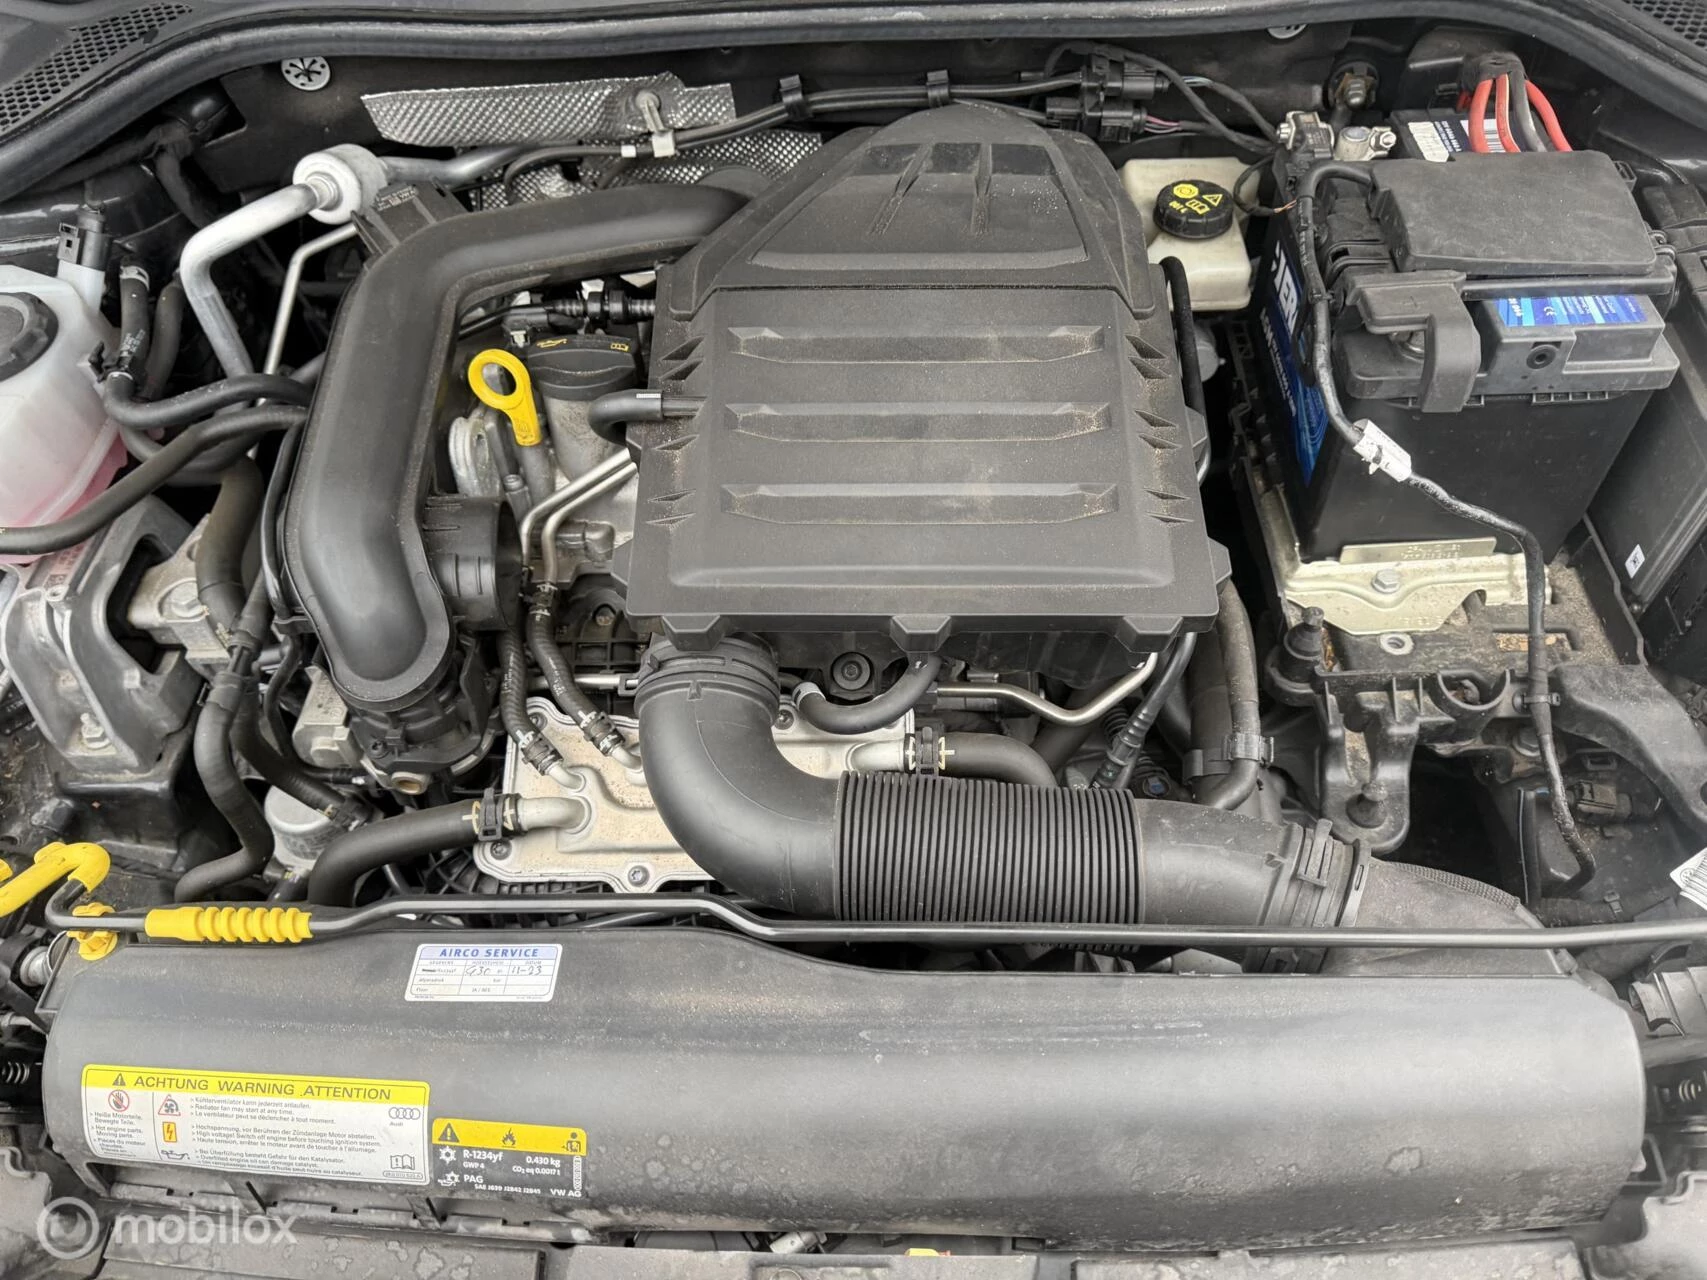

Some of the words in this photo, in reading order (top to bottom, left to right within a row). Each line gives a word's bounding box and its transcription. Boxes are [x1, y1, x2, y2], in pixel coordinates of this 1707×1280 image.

[439, 948, 479, 958] AIRCO
[484, 948, 539, 958] SERVICE
[134, 1076, 209, 1090] ACHTUNG
[218, 1080, 295, 1095] WARNING
[303, 1084, 392, 1100] ATTENTION
[463, 1150, 504, 1163] R-1234yf
[550, 1157, 560, 1168] kg
[464, 1174, 484, 1184] PAG
[550, 1188, 566, 1196] VW
[567, 1190, 582, 1198] AG
